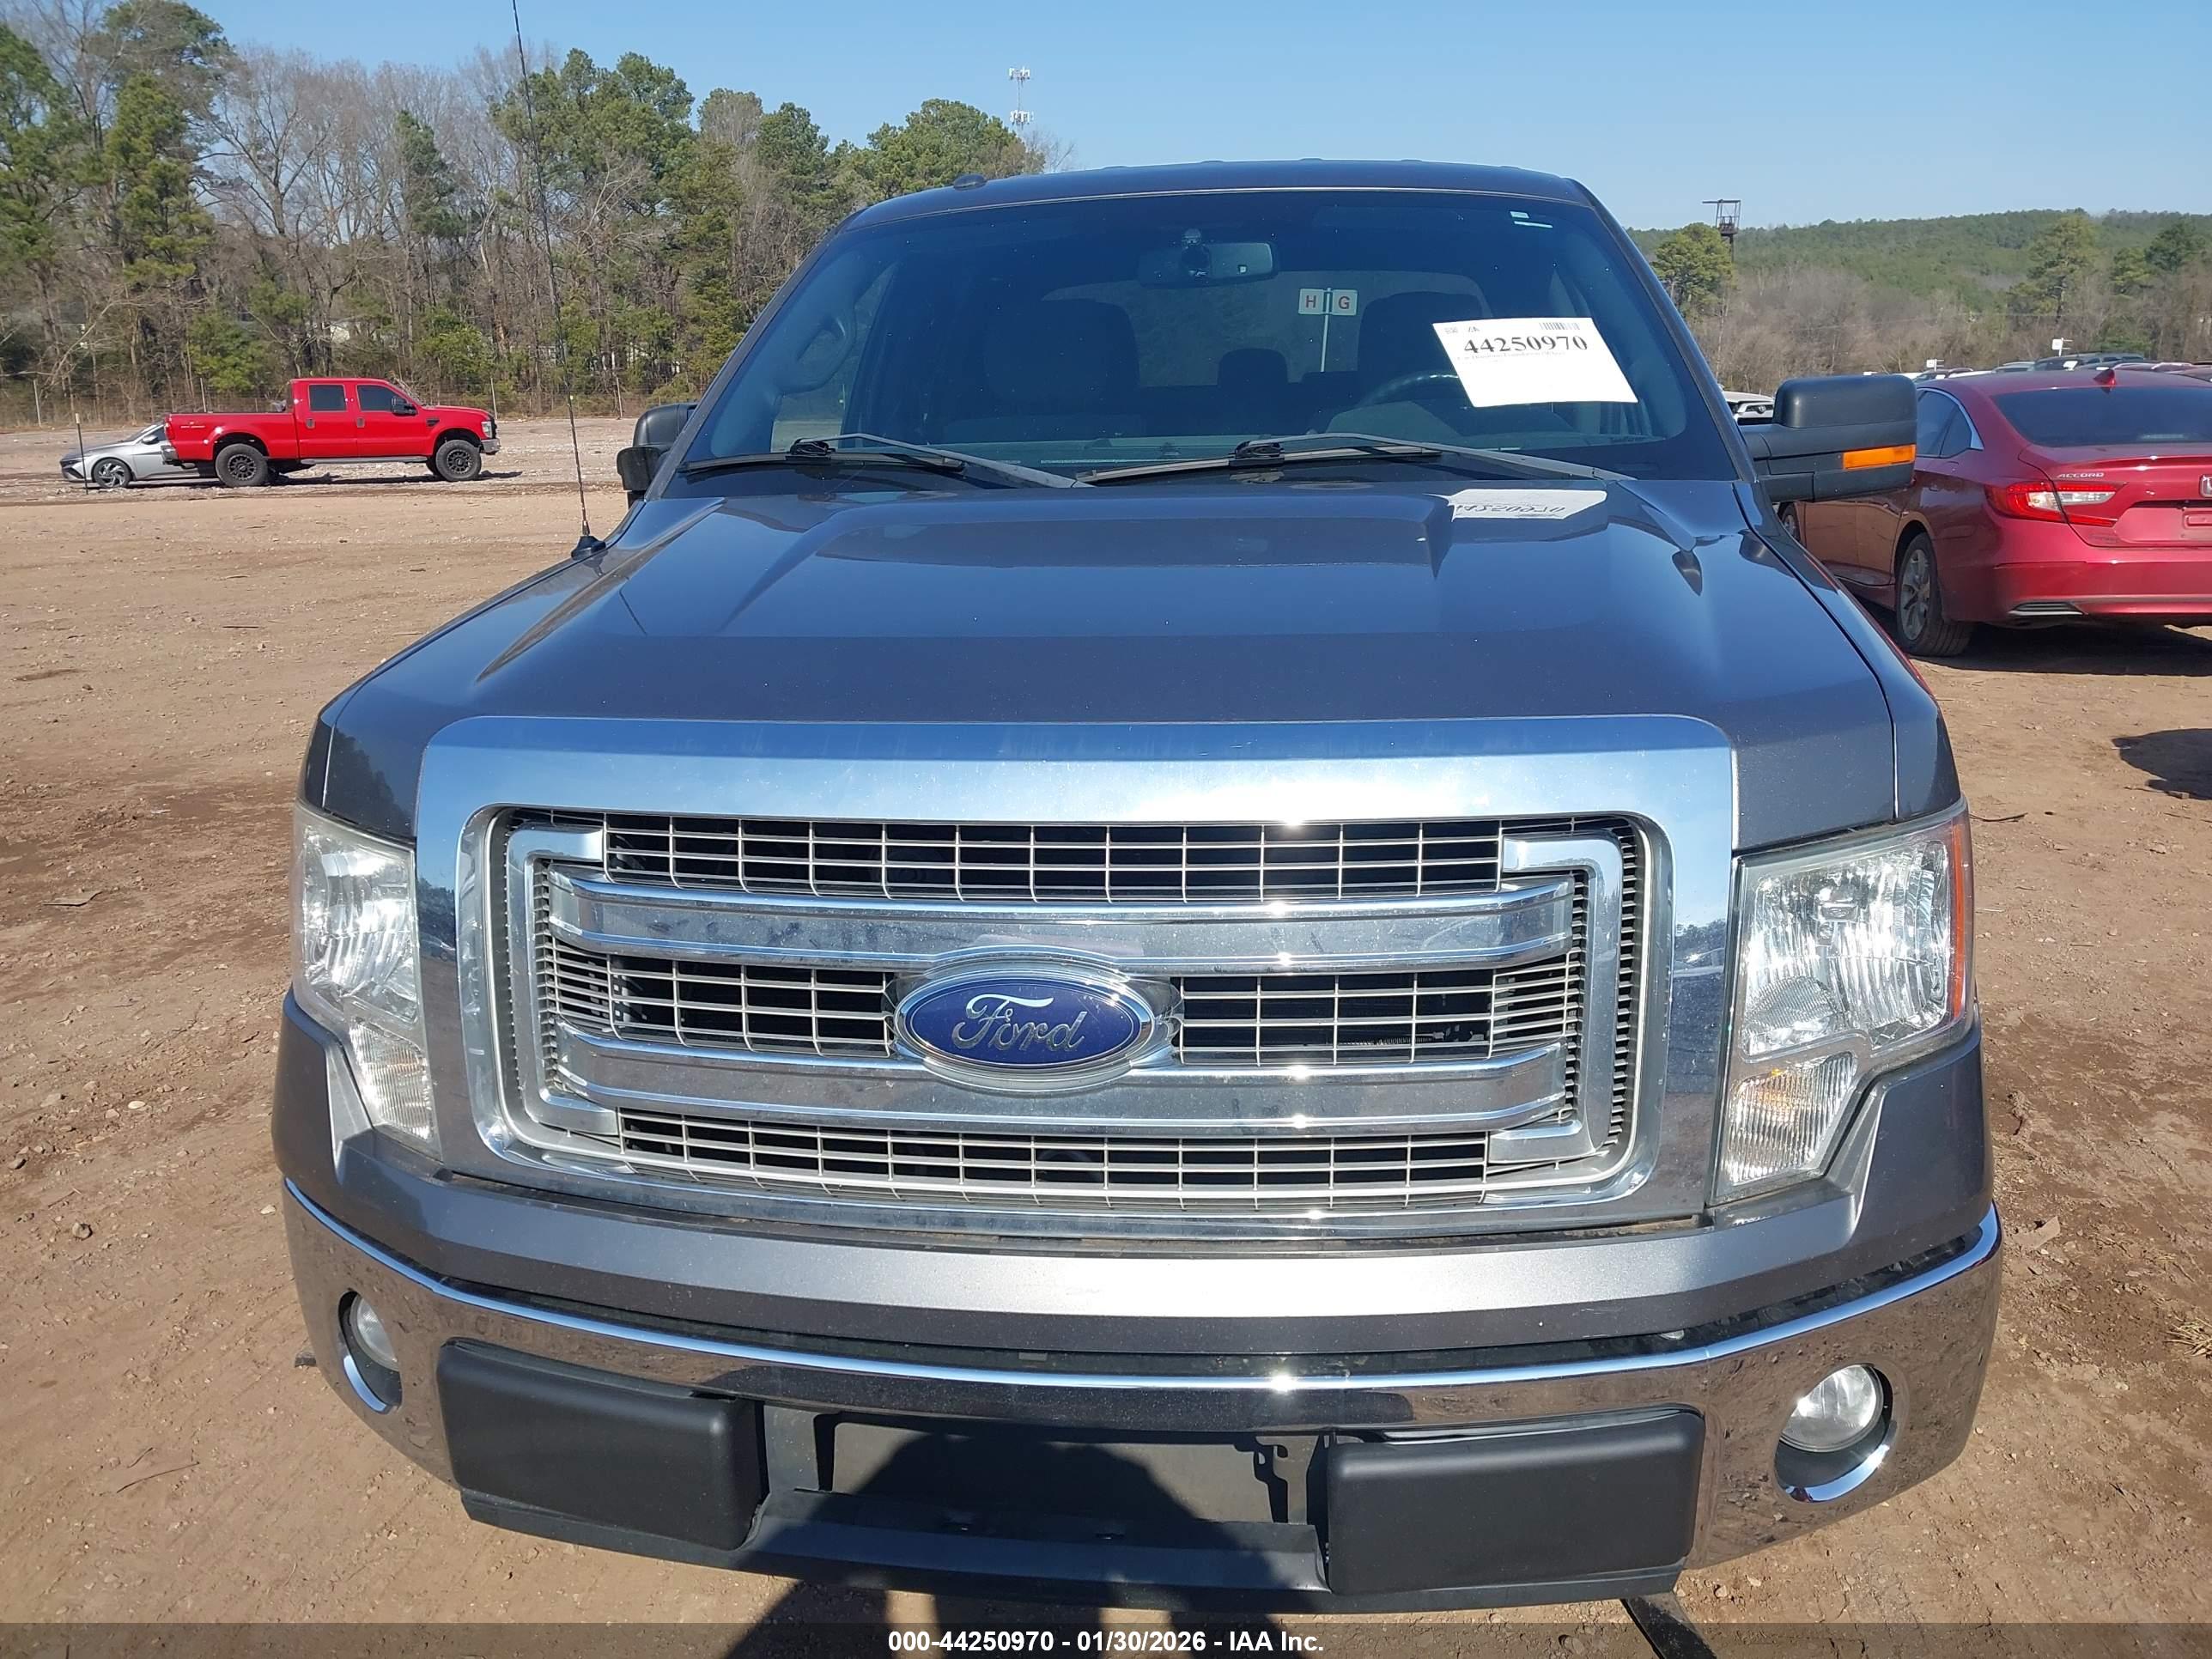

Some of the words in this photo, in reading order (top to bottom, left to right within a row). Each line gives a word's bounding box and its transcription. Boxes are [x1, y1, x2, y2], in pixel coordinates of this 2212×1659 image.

[1305, 295, 1316, 308] H
[1338, 295, 1350, 309] G
[1464, 336, 1587, 354] 44250970
[951, 994, 1087, 1051] Ford
